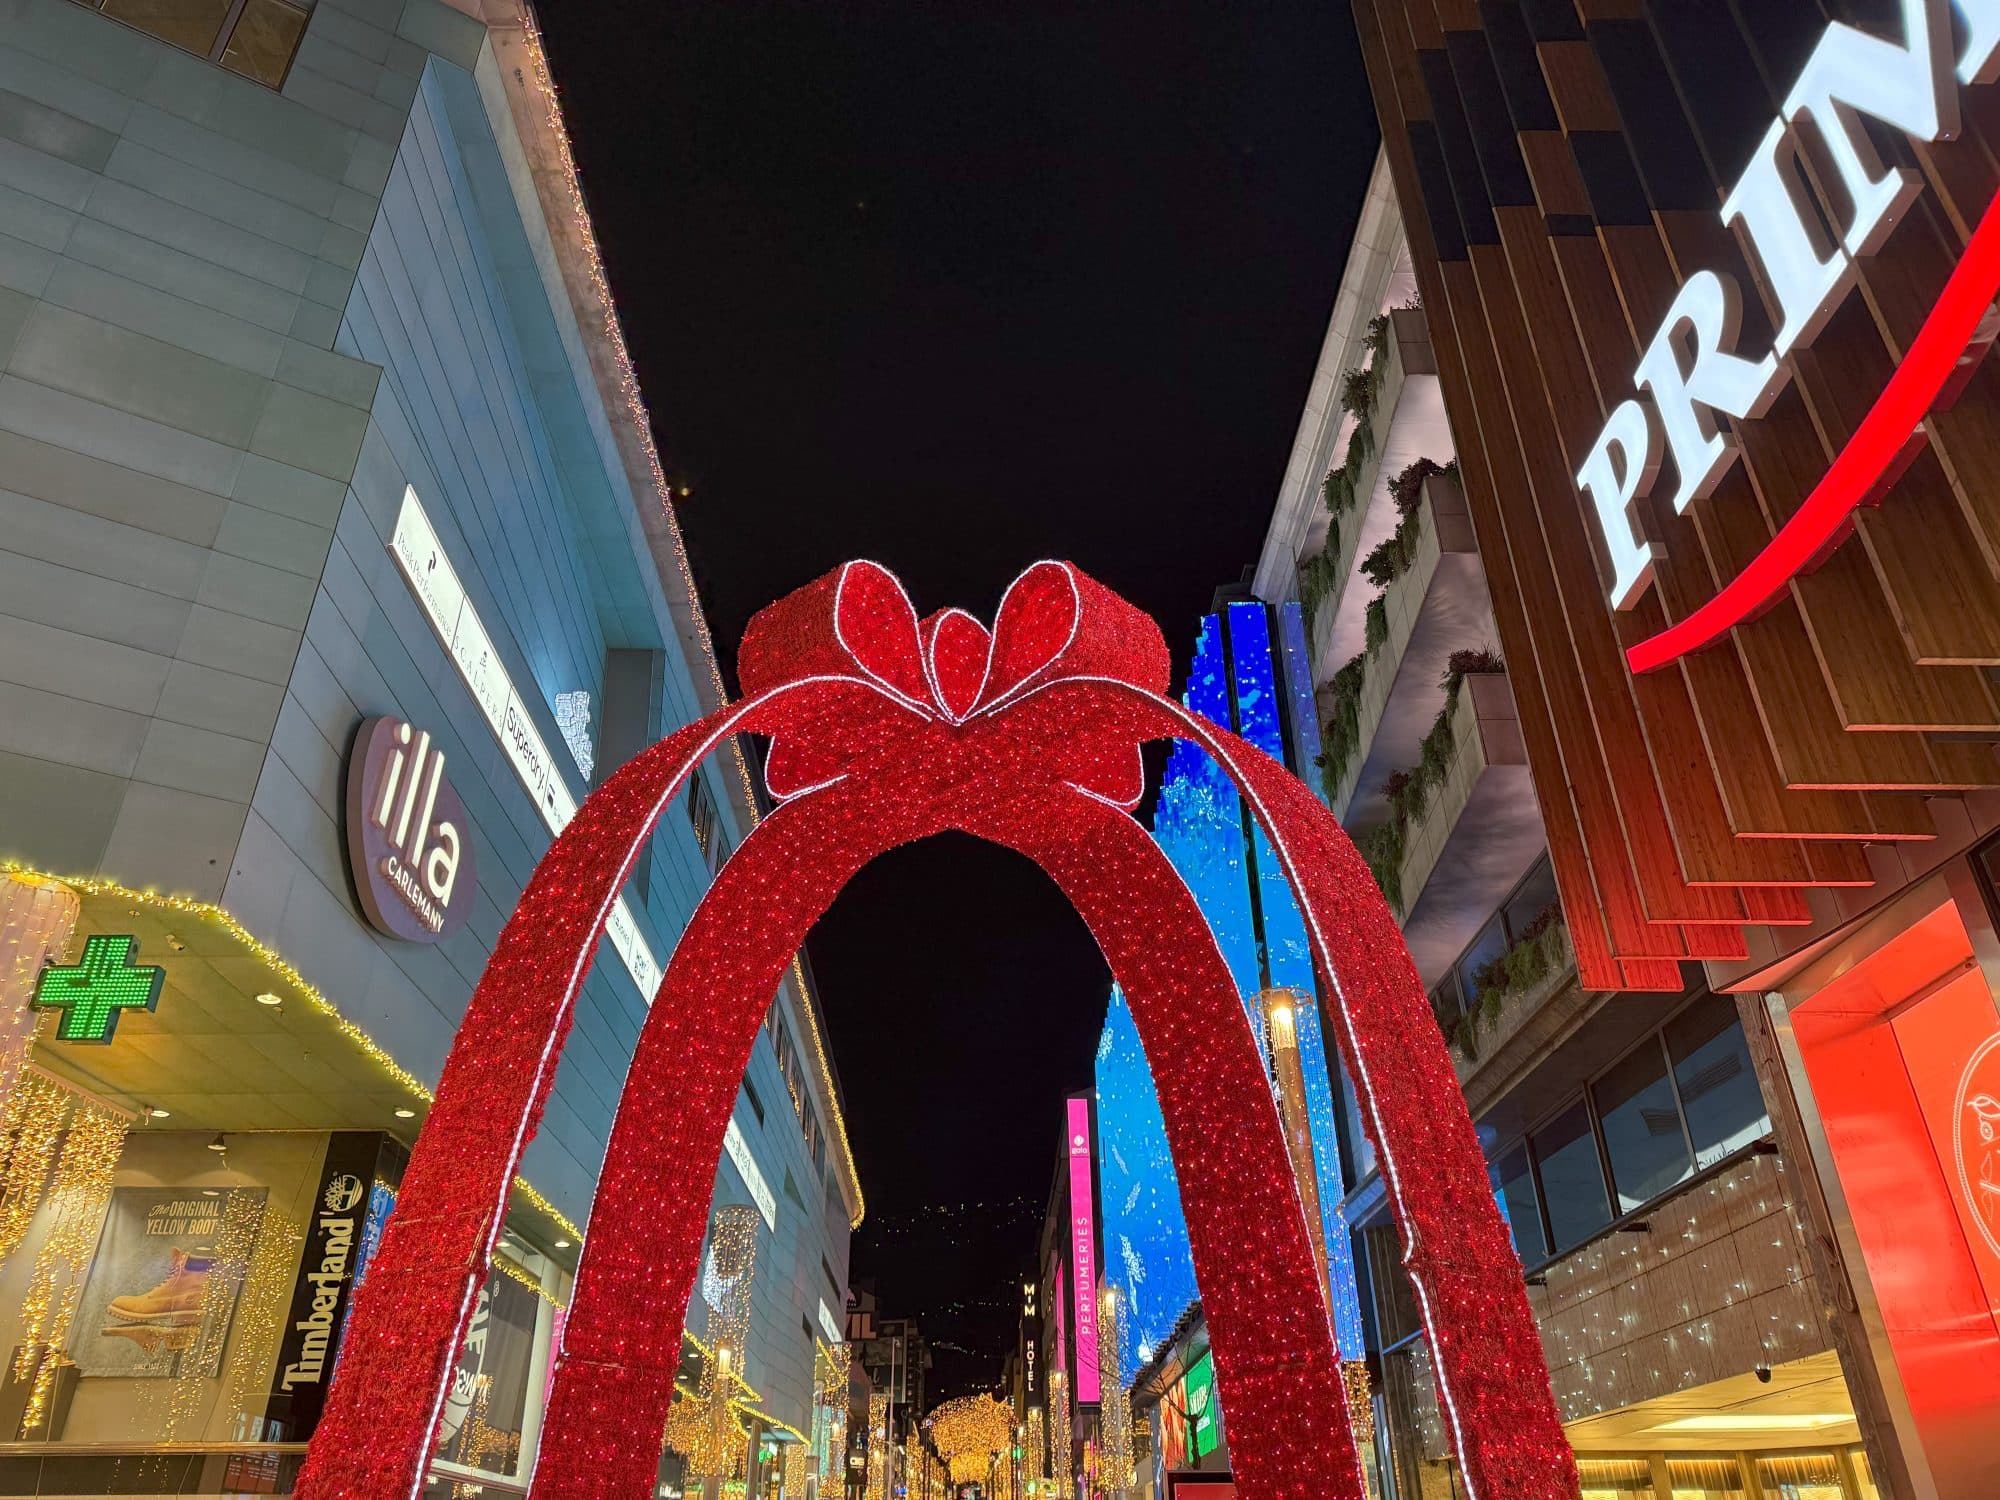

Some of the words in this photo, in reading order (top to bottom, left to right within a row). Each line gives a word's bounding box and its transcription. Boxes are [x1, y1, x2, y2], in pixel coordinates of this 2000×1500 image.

[379, 722, 460, 908] illa
[388, 856, 445, 933] CARLEMANY
[146, 1219, 186, 1235] YELLOW
[188, 1219, 218, 1235] BOOT
[149, 1202, 169, 1217] The
[170, 1201, 220, 1217] ORIGINAL
[1024, 1284, 1035, 1316] MIM
[1077, 1217, 1092, 1335] PERFUMERIES
[1027, 1340, 1035, 1391] HOTEL
